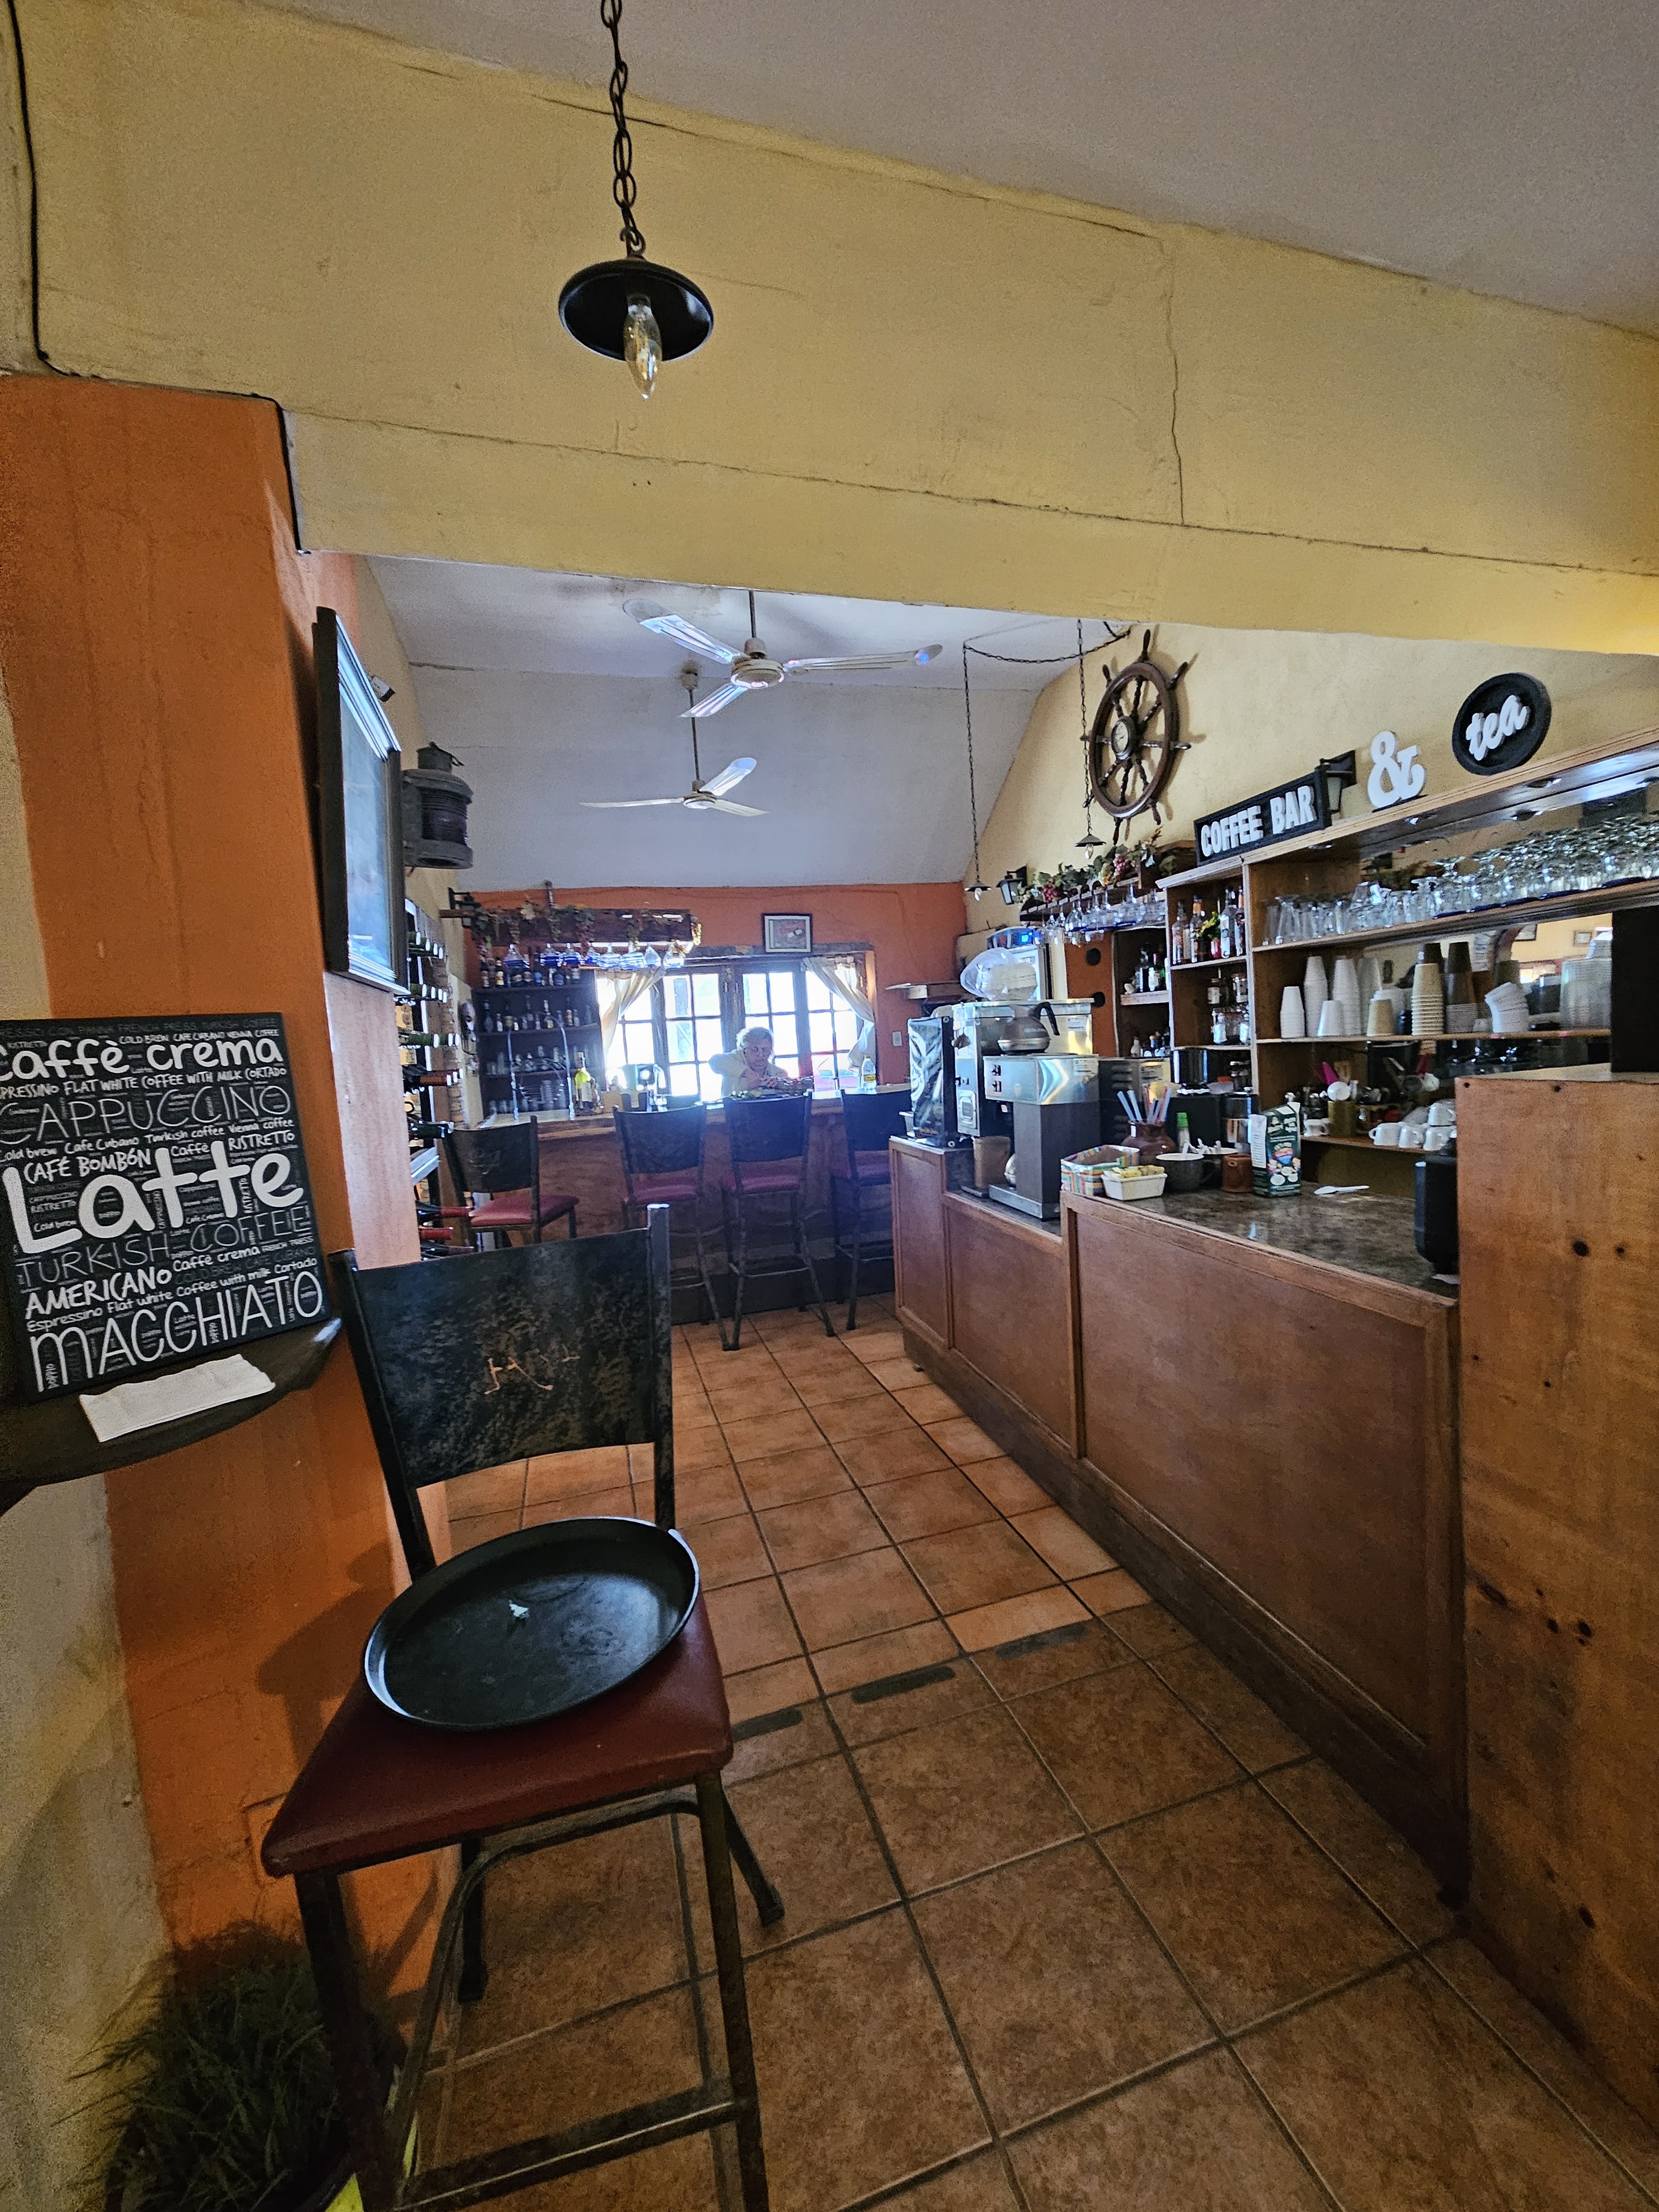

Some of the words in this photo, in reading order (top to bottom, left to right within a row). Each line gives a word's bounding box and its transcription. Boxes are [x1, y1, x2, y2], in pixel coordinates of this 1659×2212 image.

[1466, 695, 1530, 761] tea
[1367, 731, 1427, 808] &
[1201, 805, 1264, 857] COFFEE
[1270, 785, 1317, 834] BAR
[62, 1079, 99, 1095] FLAT
[100, 1077, 139, 1091] WHITE
[142, 1073, 184, 1089] COFFEE
[186, 1071, 213, 1084] WITH
[217, 1070, 243, 1082] MILK
[245, 1066, 287, 1081] CORTADO
[146, 1038, 283, 1071] crema
[0, 1148, 24, 1163] old
[64, 1139, 95, 1154] Cafe
[96, 1136, 140, 1150] Cubano
[144, 1130, 188, 1144] Turkish
[191, 1124, 226, 1138] coffee
[228, 1123, 259, 1133] Vienna
[263, 1117, 295, 1129] coffee
[170, 1142, 210, 1156] Caffè
[228, 1129, 295, 1151] RISTRETTO
[2, 1141, 304, 1254] Latte
[15, 1233, 169, 1287] TURKISH
[190, 1205, 312, 1252] COFFEE
[173, 1255, 213, 1271] Caffè
[217, 1246, 260, 1262] crema
[25, 1266, 172, 1320] AMERICANO
[26, 1307, 103, 1333] Espressino
[107, 1298, 134, 1313] Flat
[136, 1290, 174, 1306] white
[176, 1280, 218, 1297] Coffee
[219, 1273, 247, 1287] with
[274, 1258, 317, 1274] Cortado
[30, 1271, 323, 1392] MACCHIATO
